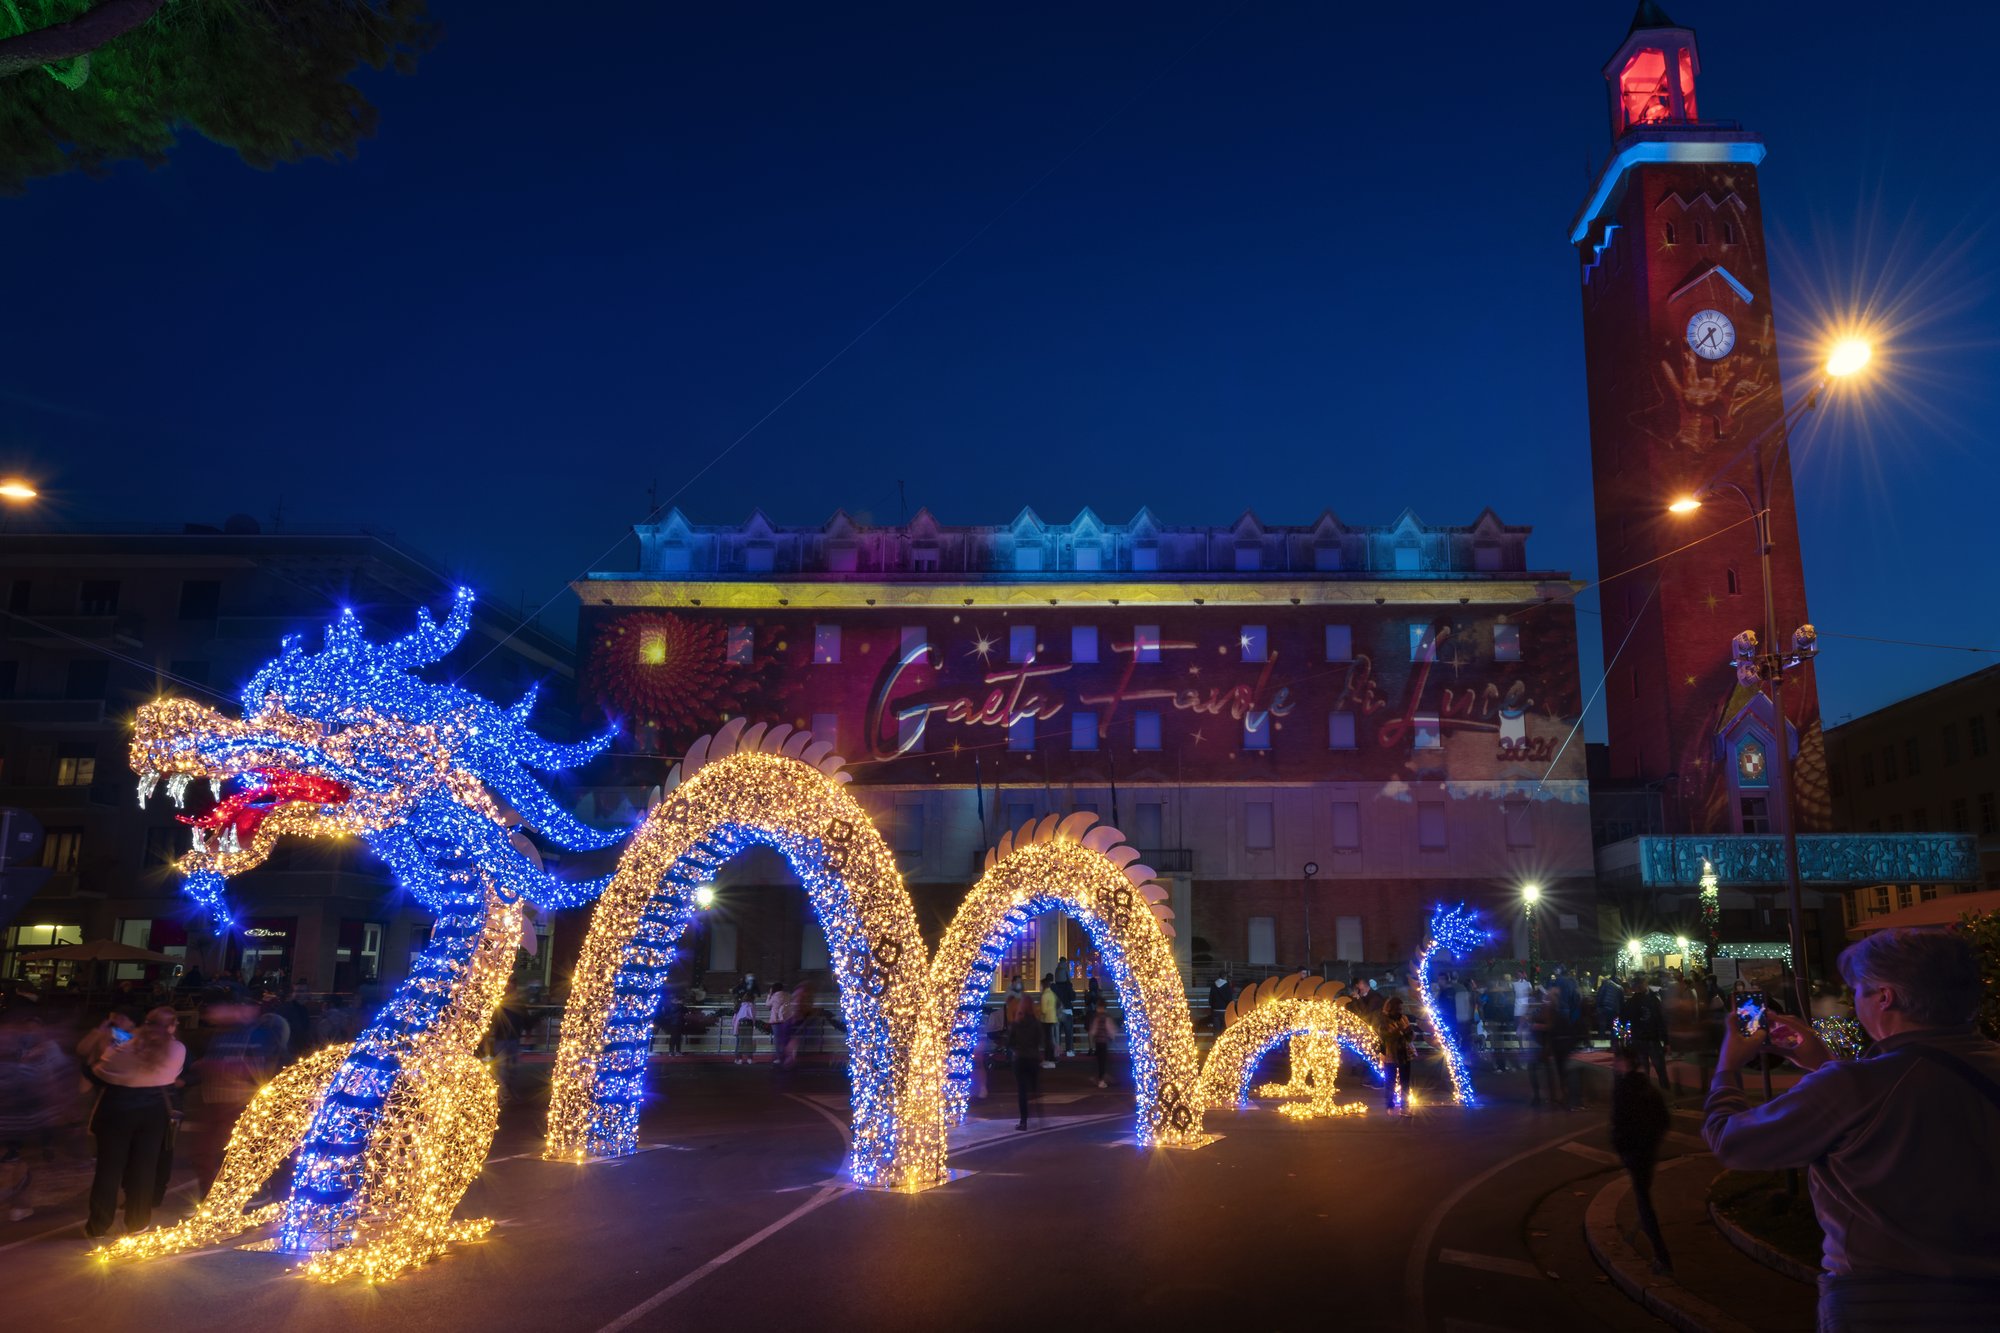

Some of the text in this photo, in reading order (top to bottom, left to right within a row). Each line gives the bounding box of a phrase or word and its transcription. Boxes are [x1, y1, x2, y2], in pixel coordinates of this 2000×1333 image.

[868, 641, 1072, 763] Gaeta
[1080, 635, 1296, 738] Favole
[1379, 625, 1535, 749] Luce
[1496, 736, 1559, 762] 2021
